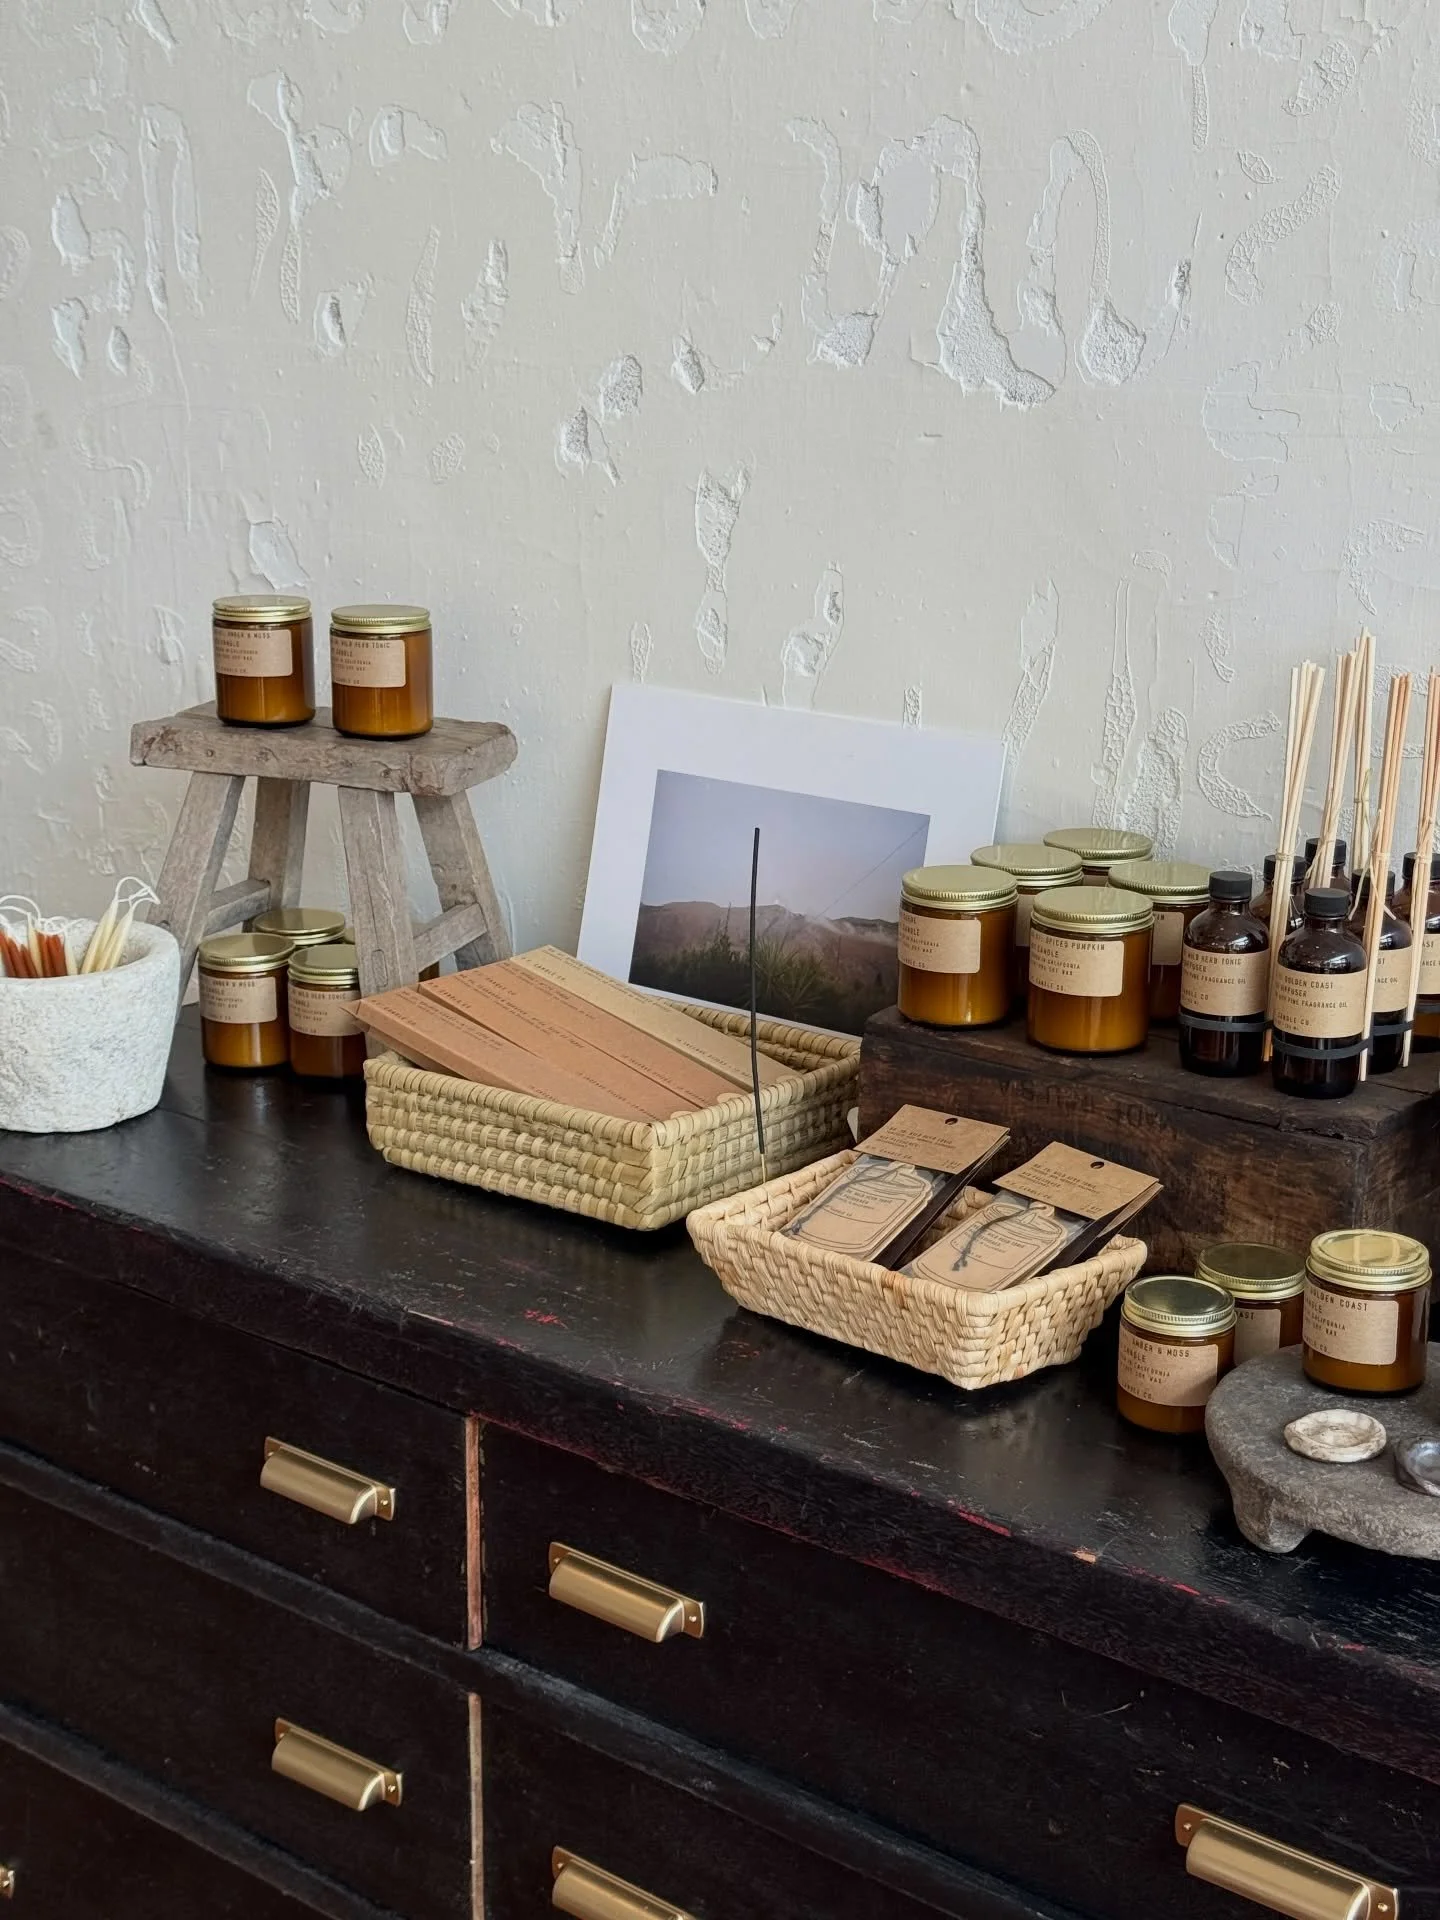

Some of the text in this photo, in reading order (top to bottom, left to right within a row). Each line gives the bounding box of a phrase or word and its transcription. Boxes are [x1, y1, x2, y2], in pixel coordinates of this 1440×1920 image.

[1071, 942, 1105, 951] PUMPKIN
[1221, 957, 1242, 966] TONIC
[1201, 975, 1235, 985] FRAGRANCE
[1284, 975, 1334, 990] GOLDEN COAST
[1301, 999, 1337, 1009] FRAGRANCE
[1339, 1298, 1368, 1312] COAST
[1132, 1337, 1153, 1353] AMBER
[1166, 1347, 1191, 1358] MOSS
